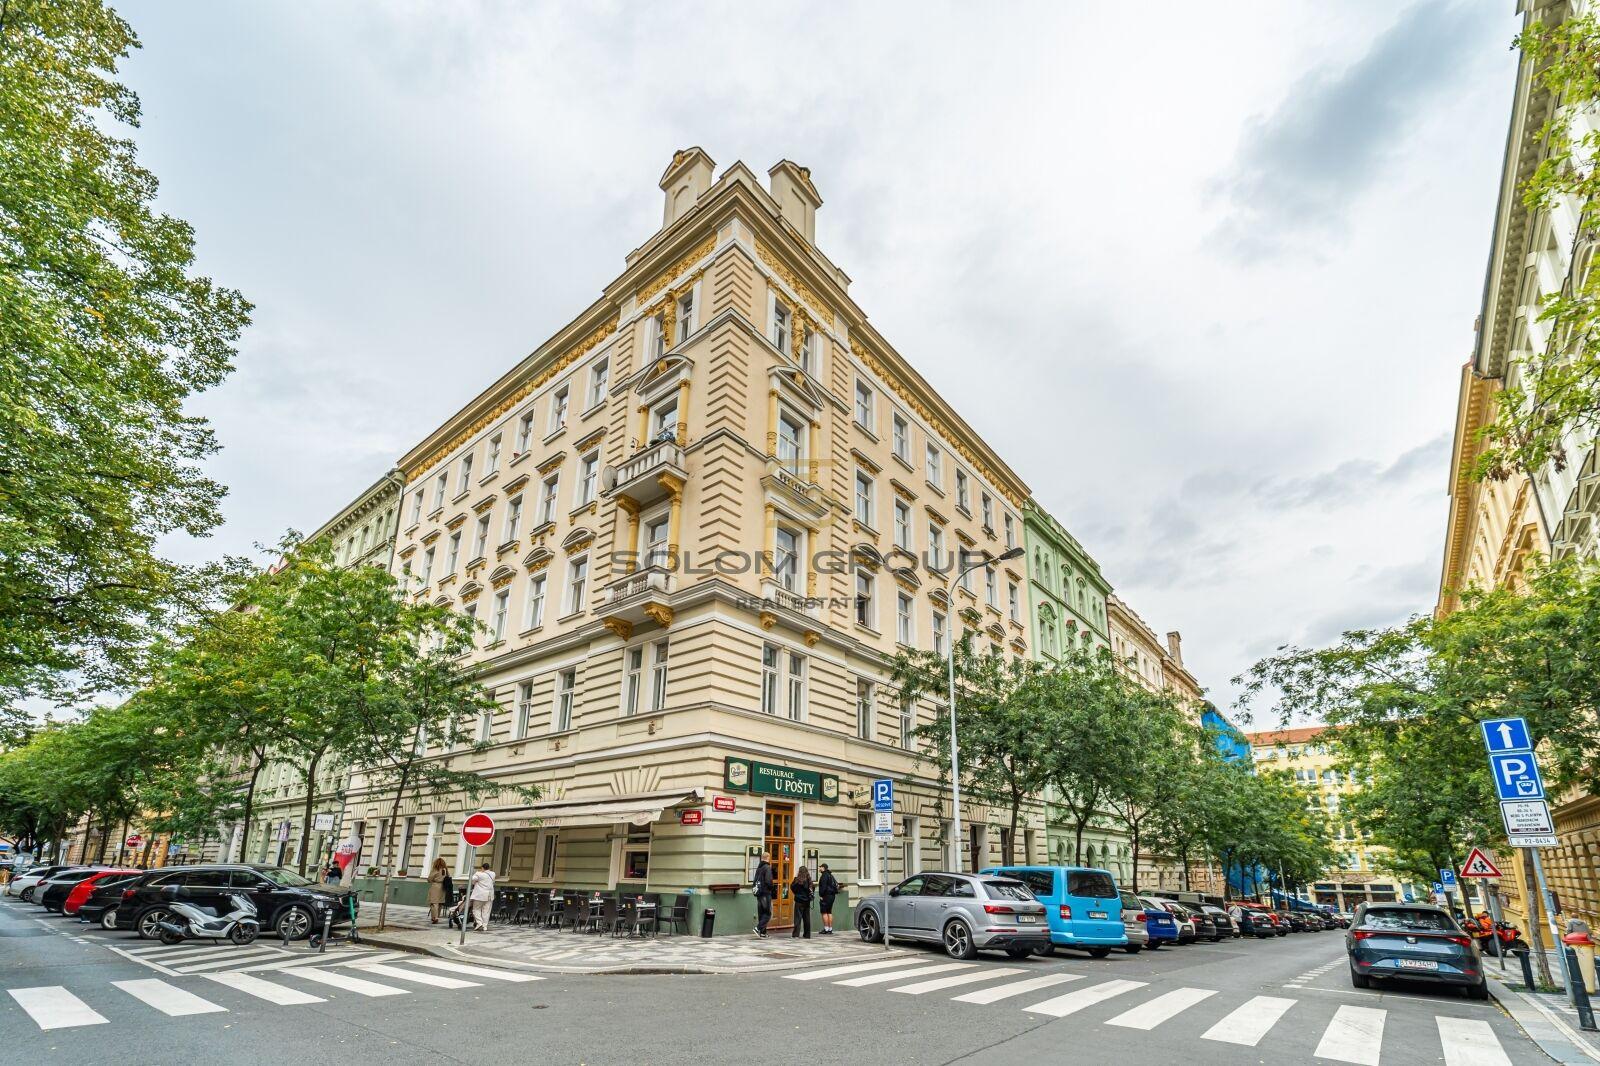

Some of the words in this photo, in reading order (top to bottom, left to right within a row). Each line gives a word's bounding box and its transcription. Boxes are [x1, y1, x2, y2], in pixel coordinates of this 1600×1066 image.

[759, 767, 795, 780] RESTAURACE
[1500, 758, 1527, 786] P
[775, 778, 783, 791] U
[785, 779, 815, 796] POŠTY
[877, 784, 889, 802] P
